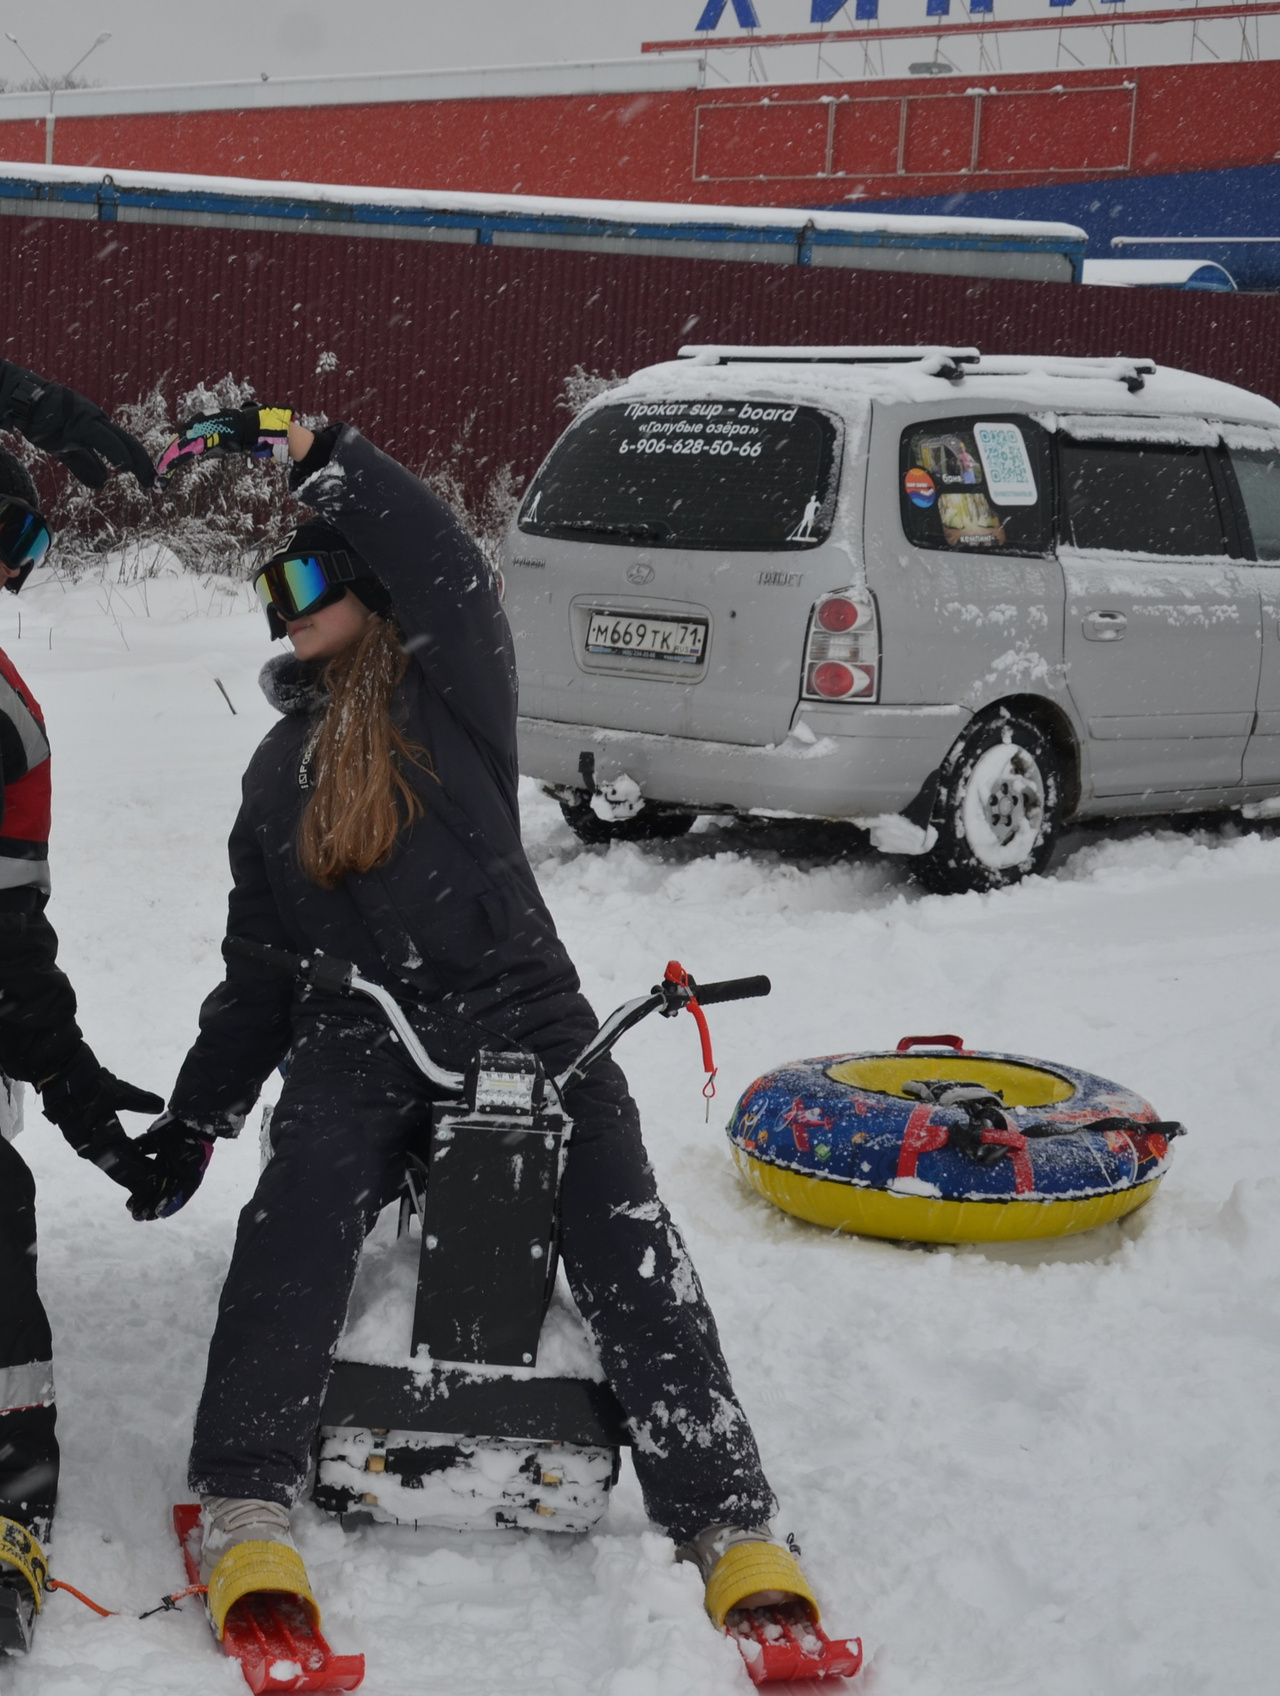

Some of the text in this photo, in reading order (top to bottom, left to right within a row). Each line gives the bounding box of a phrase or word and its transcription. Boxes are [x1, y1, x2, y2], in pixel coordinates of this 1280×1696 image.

[624, 403, 687, 420] Прокат
[689, 403, 723, 420] sup
[738, 402, 799, 422] board
